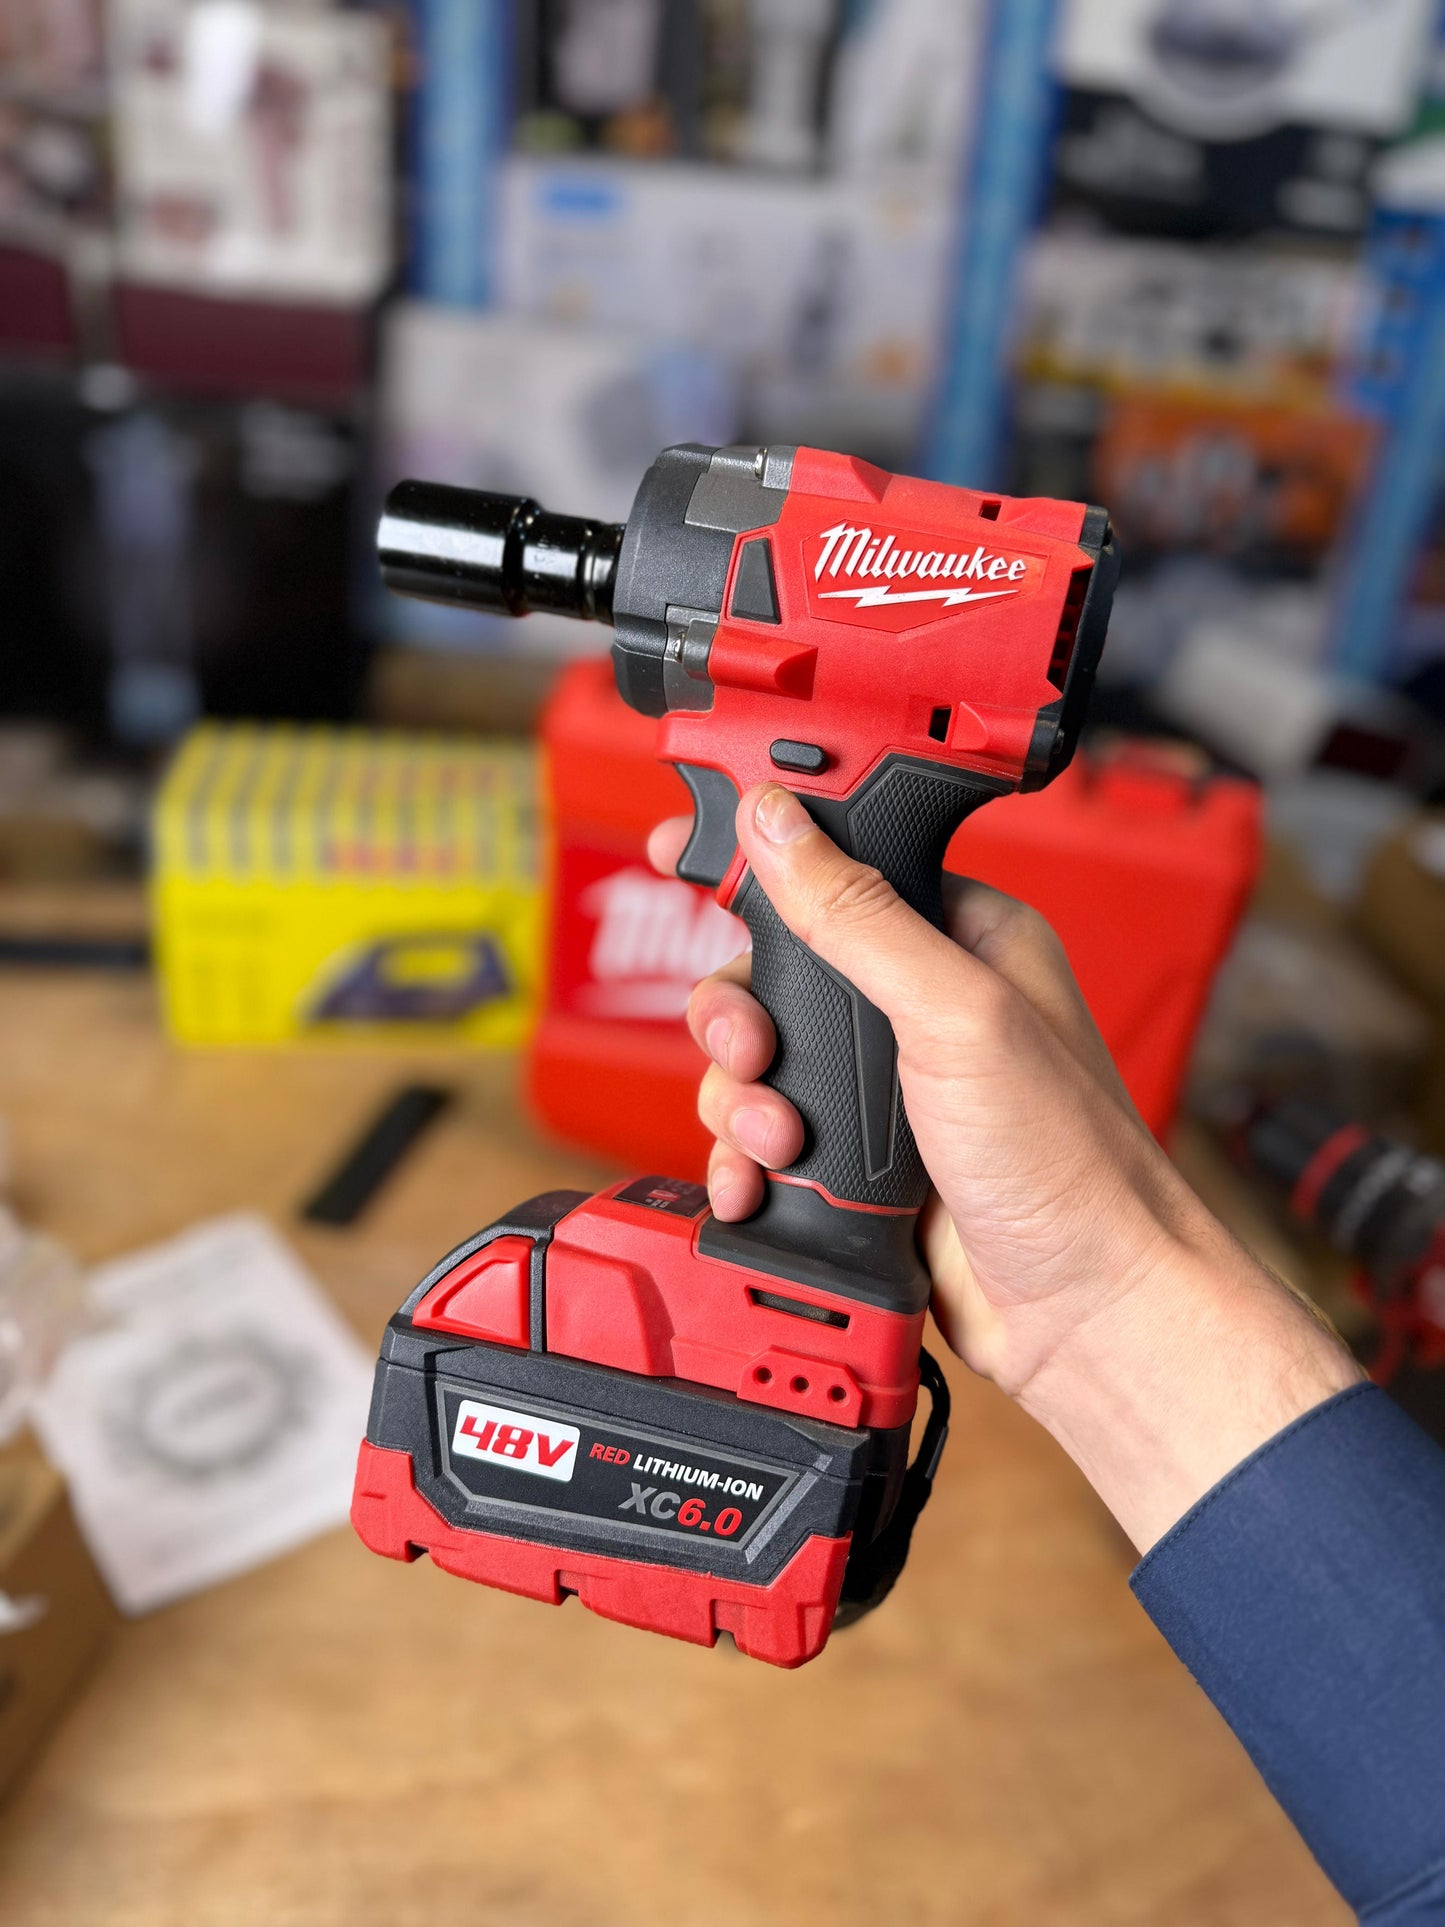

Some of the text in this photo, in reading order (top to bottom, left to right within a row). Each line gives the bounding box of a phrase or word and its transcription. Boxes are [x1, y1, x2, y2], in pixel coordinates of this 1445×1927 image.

[814, 523, 1027, 583] Milwaukee
[460, 1415, 575, 1468] 48V
[589, 1442, 764, 1501] RED LITHIUM-ION
[618, 1482, 743, 1537] XC6.0
